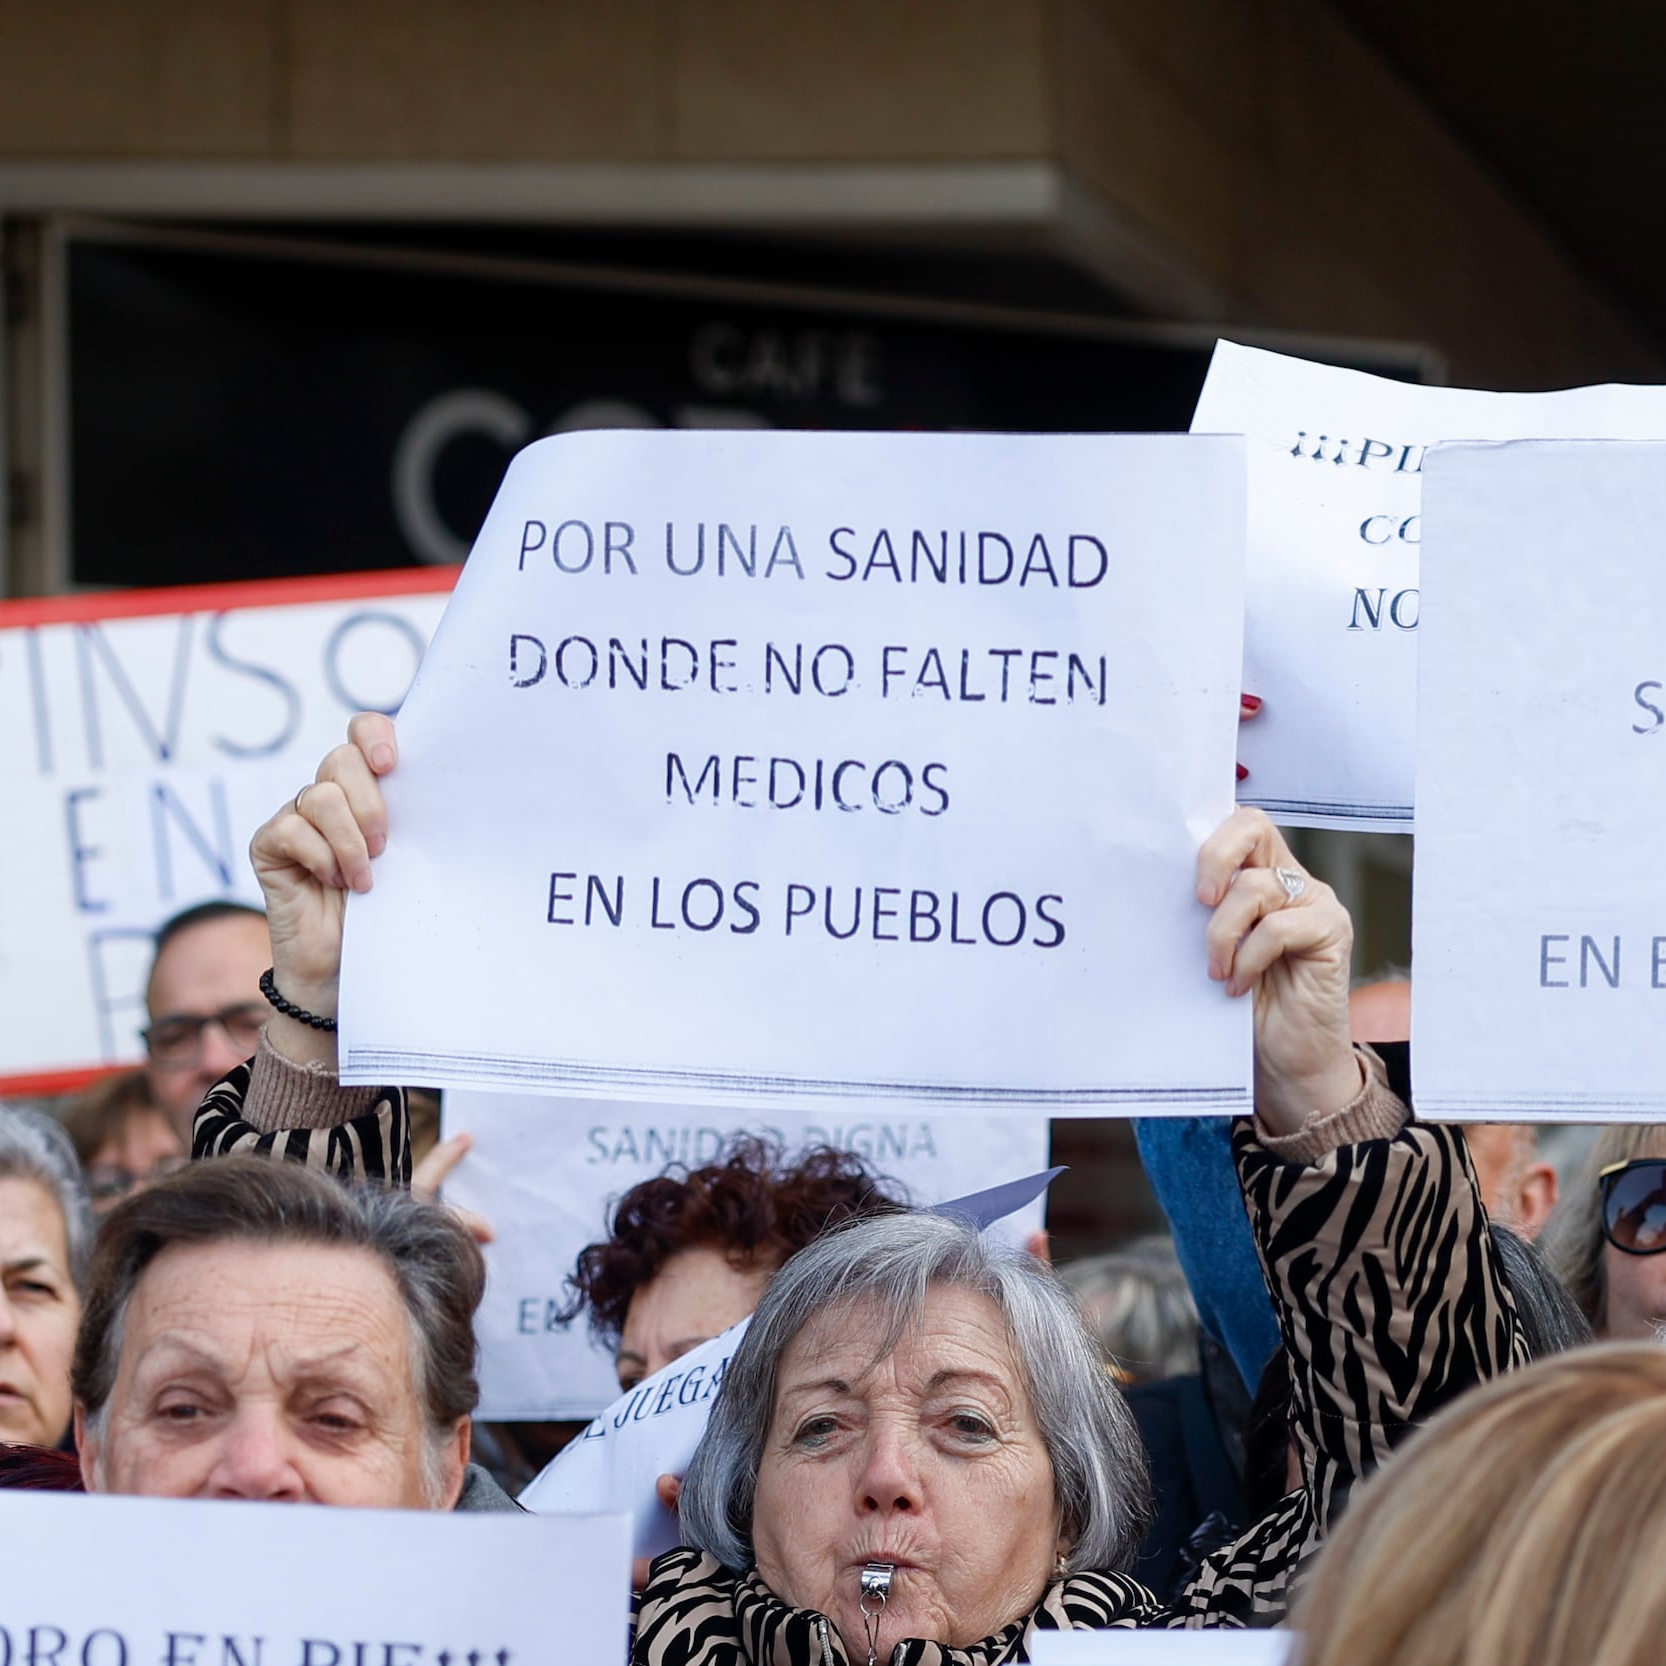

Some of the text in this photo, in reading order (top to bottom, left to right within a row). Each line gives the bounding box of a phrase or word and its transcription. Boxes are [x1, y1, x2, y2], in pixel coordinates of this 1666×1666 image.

[1289, 430, 1427, 475] ¡¡¡PI
[517, 519, 1109, 589] POR UNA SANIDAD
[1346, 587, 1420, 632] NO
[507, 634, 1108, 706] DONDE NO FALTEN
[665, 752, 951, 816] MEDICOS
[65, 778, 241, 912] EN
[547, 872, 1068, 949] EN LOS PUEBLOS
[1539, 934, 1621, 990] EN
